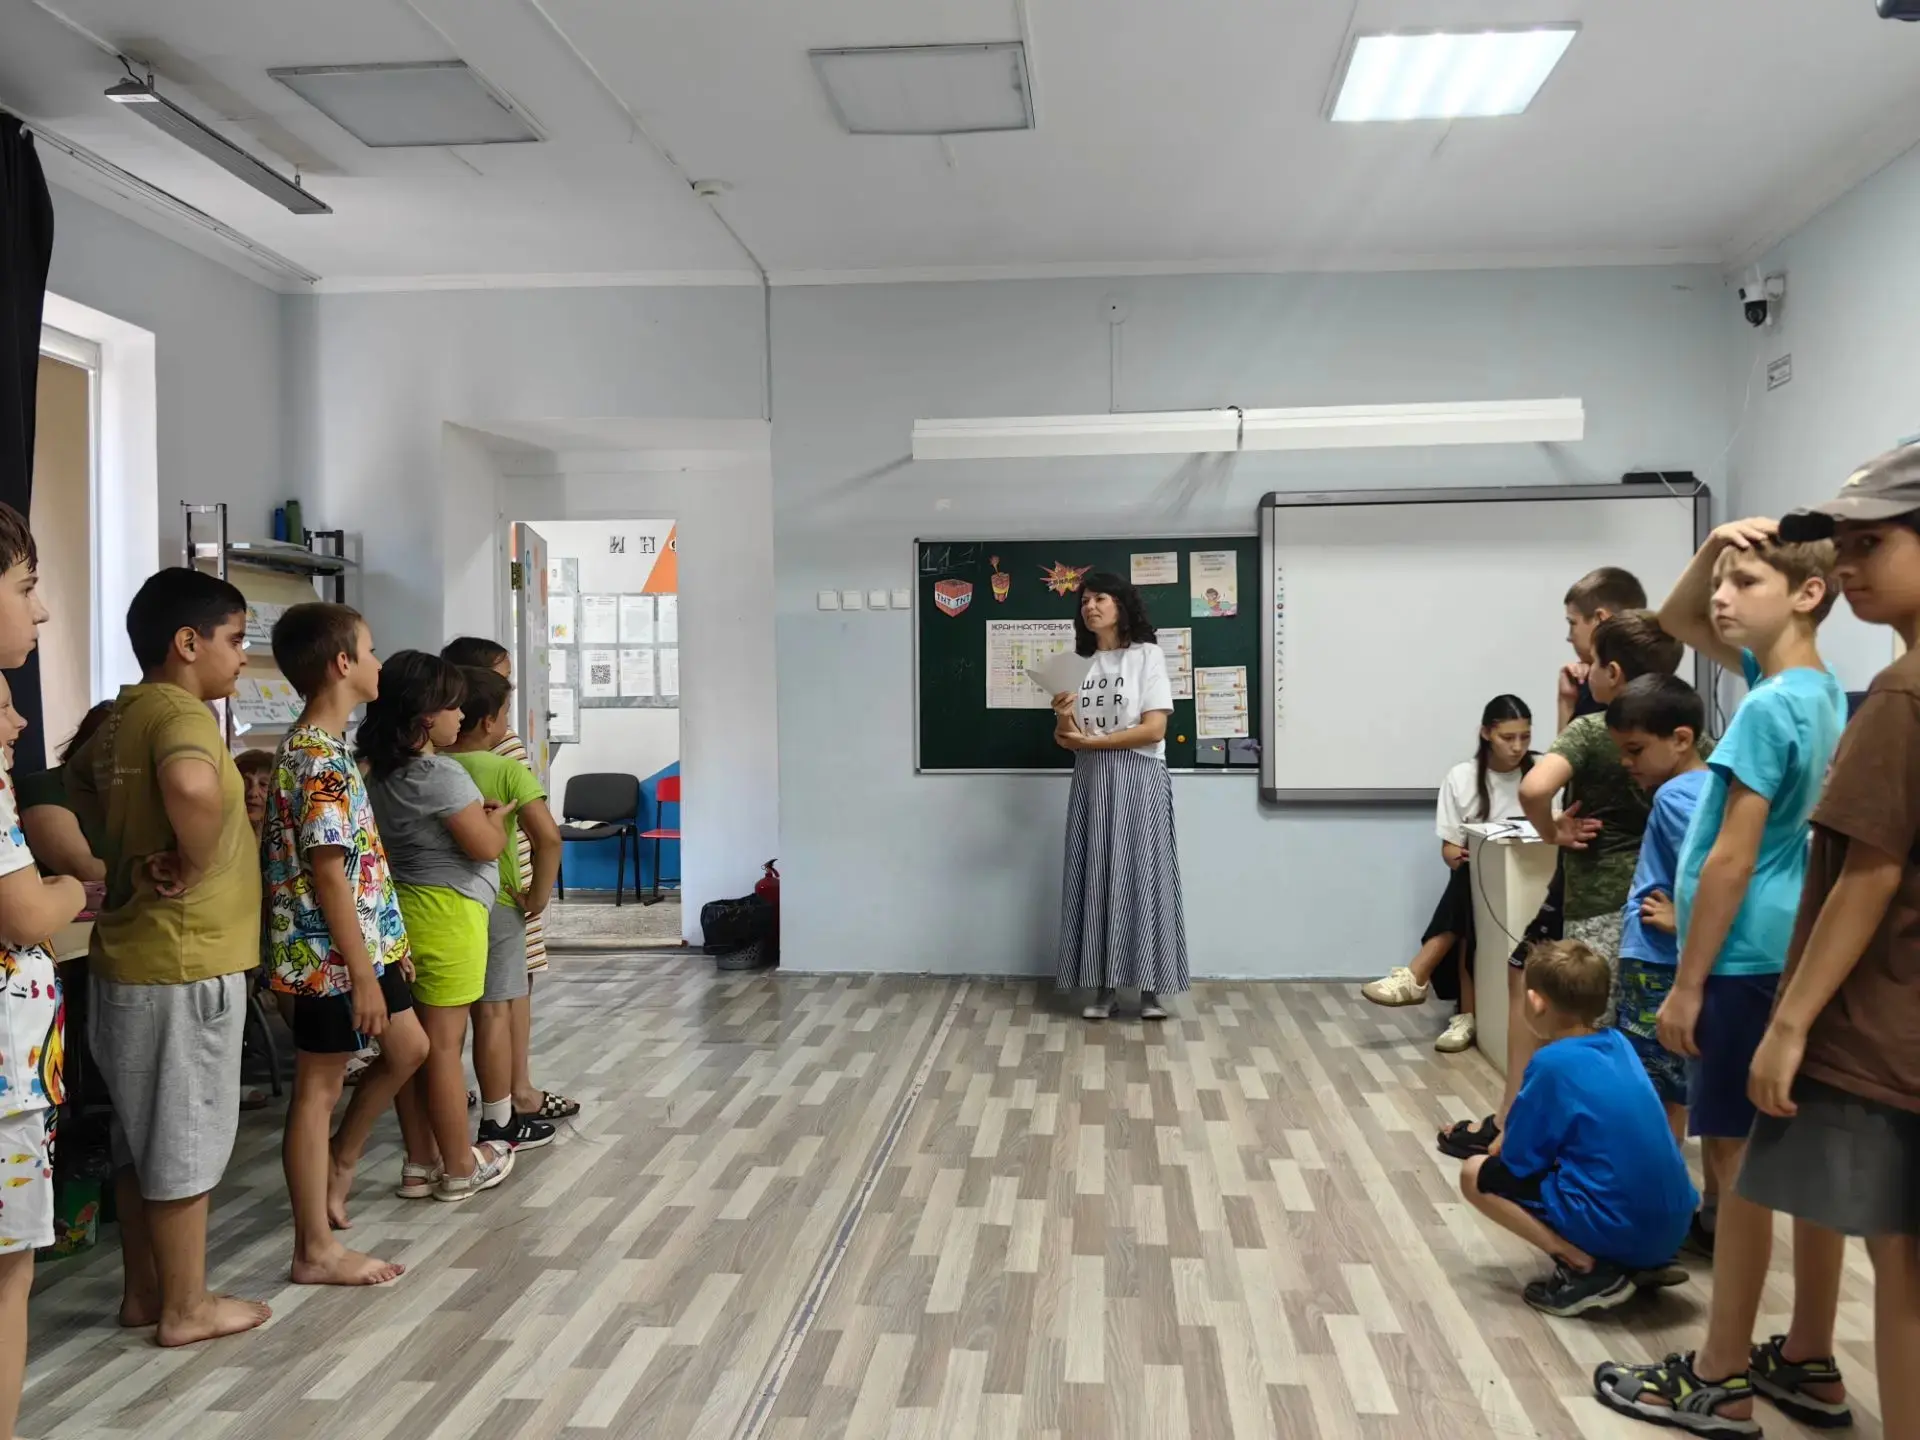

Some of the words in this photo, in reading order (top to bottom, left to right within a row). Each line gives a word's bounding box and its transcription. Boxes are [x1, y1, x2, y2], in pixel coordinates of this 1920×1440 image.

[937, 592, 951, 606] TNT
[955, 591, 972, 606] TNT
[1016, 623, 1072, 631] НАСТРОЕНИЯ
[1082, 693, 1123, 708] DER
